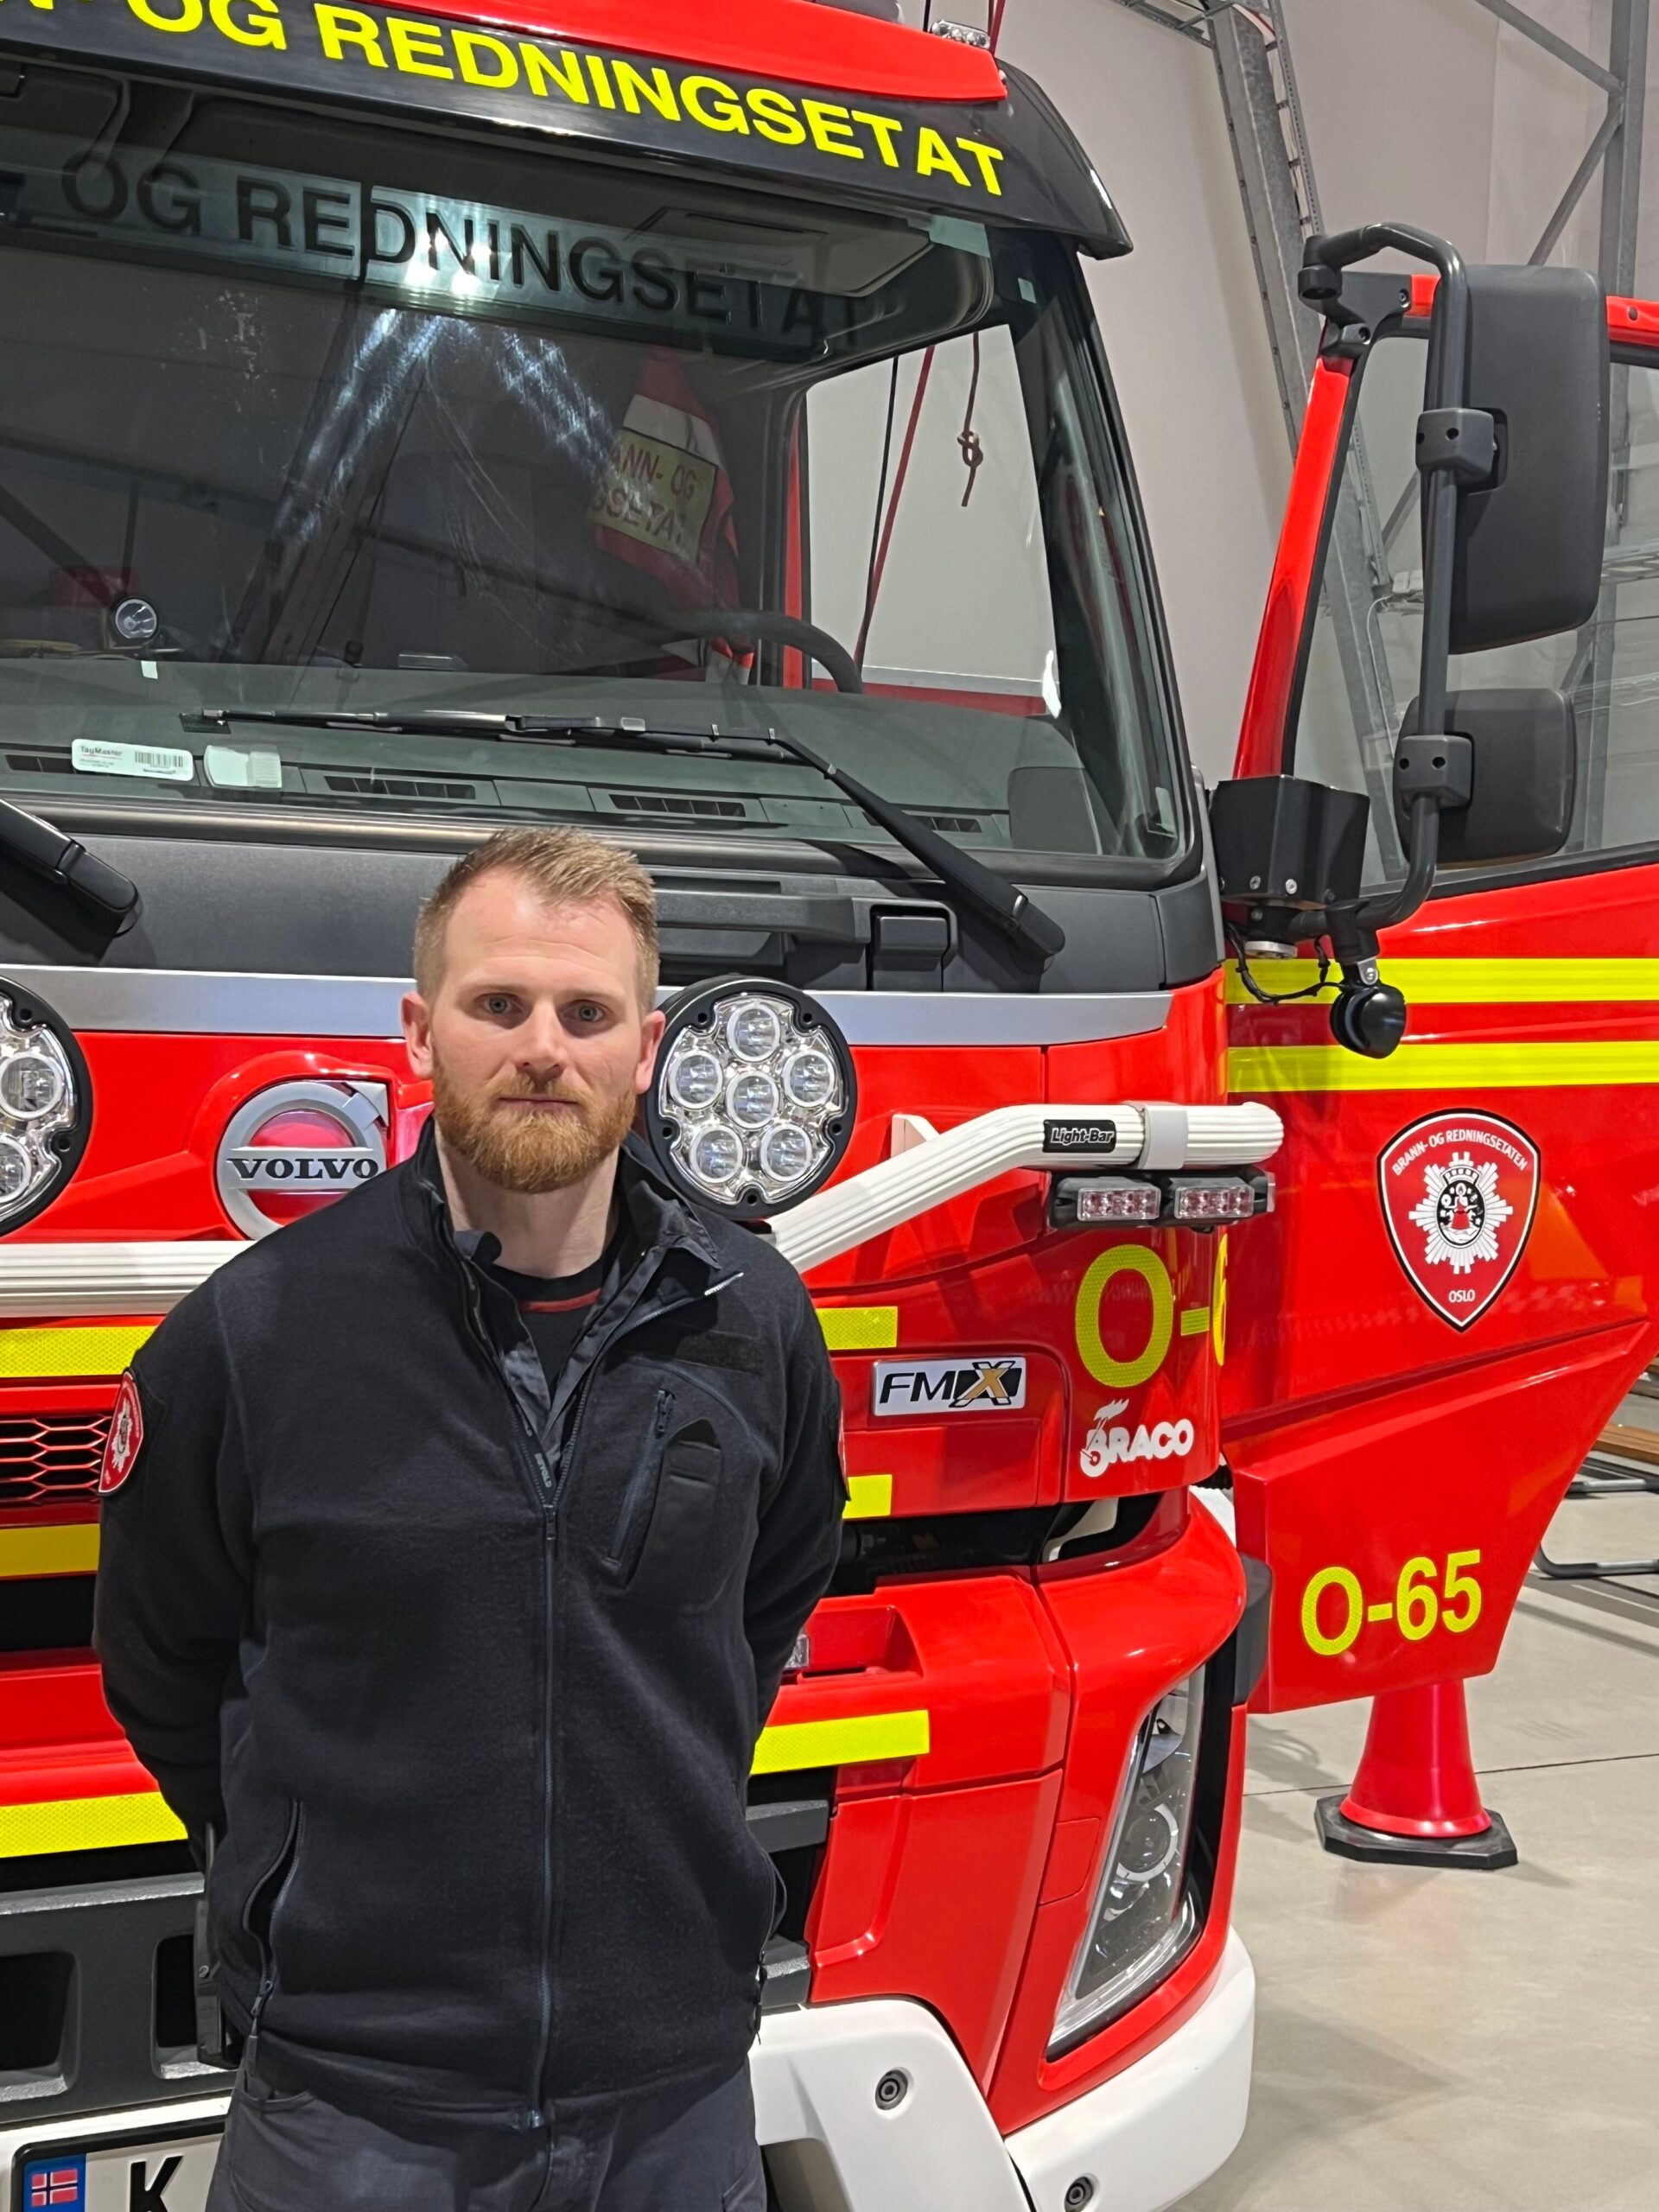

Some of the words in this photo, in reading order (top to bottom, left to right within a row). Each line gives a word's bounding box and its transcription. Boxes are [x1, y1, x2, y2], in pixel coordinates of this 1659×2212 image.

[128, 0, 287, 50] OG
[314, 3, 1004, 195] REDNINGSETAT
[1050, 1127, 1115, 1146] Light-Bar
[1392, 1141, 1429, 1176] BRANN-
[1428, 1132, 1446, 1147] OG
[1446, 1128, 1529, 1171] REDNINGSETATEN
[226, 1158, 379, 1179] VOLVO
[1448, 1289, 1476, 1303] OSLO
[880, 1360, 1017, 1408] FMX
[1080, 1418, 1194, 1478] BRACO
[1301, 1549, 1482, 1656] O-65
[130, 2155, 185, 2212] K
